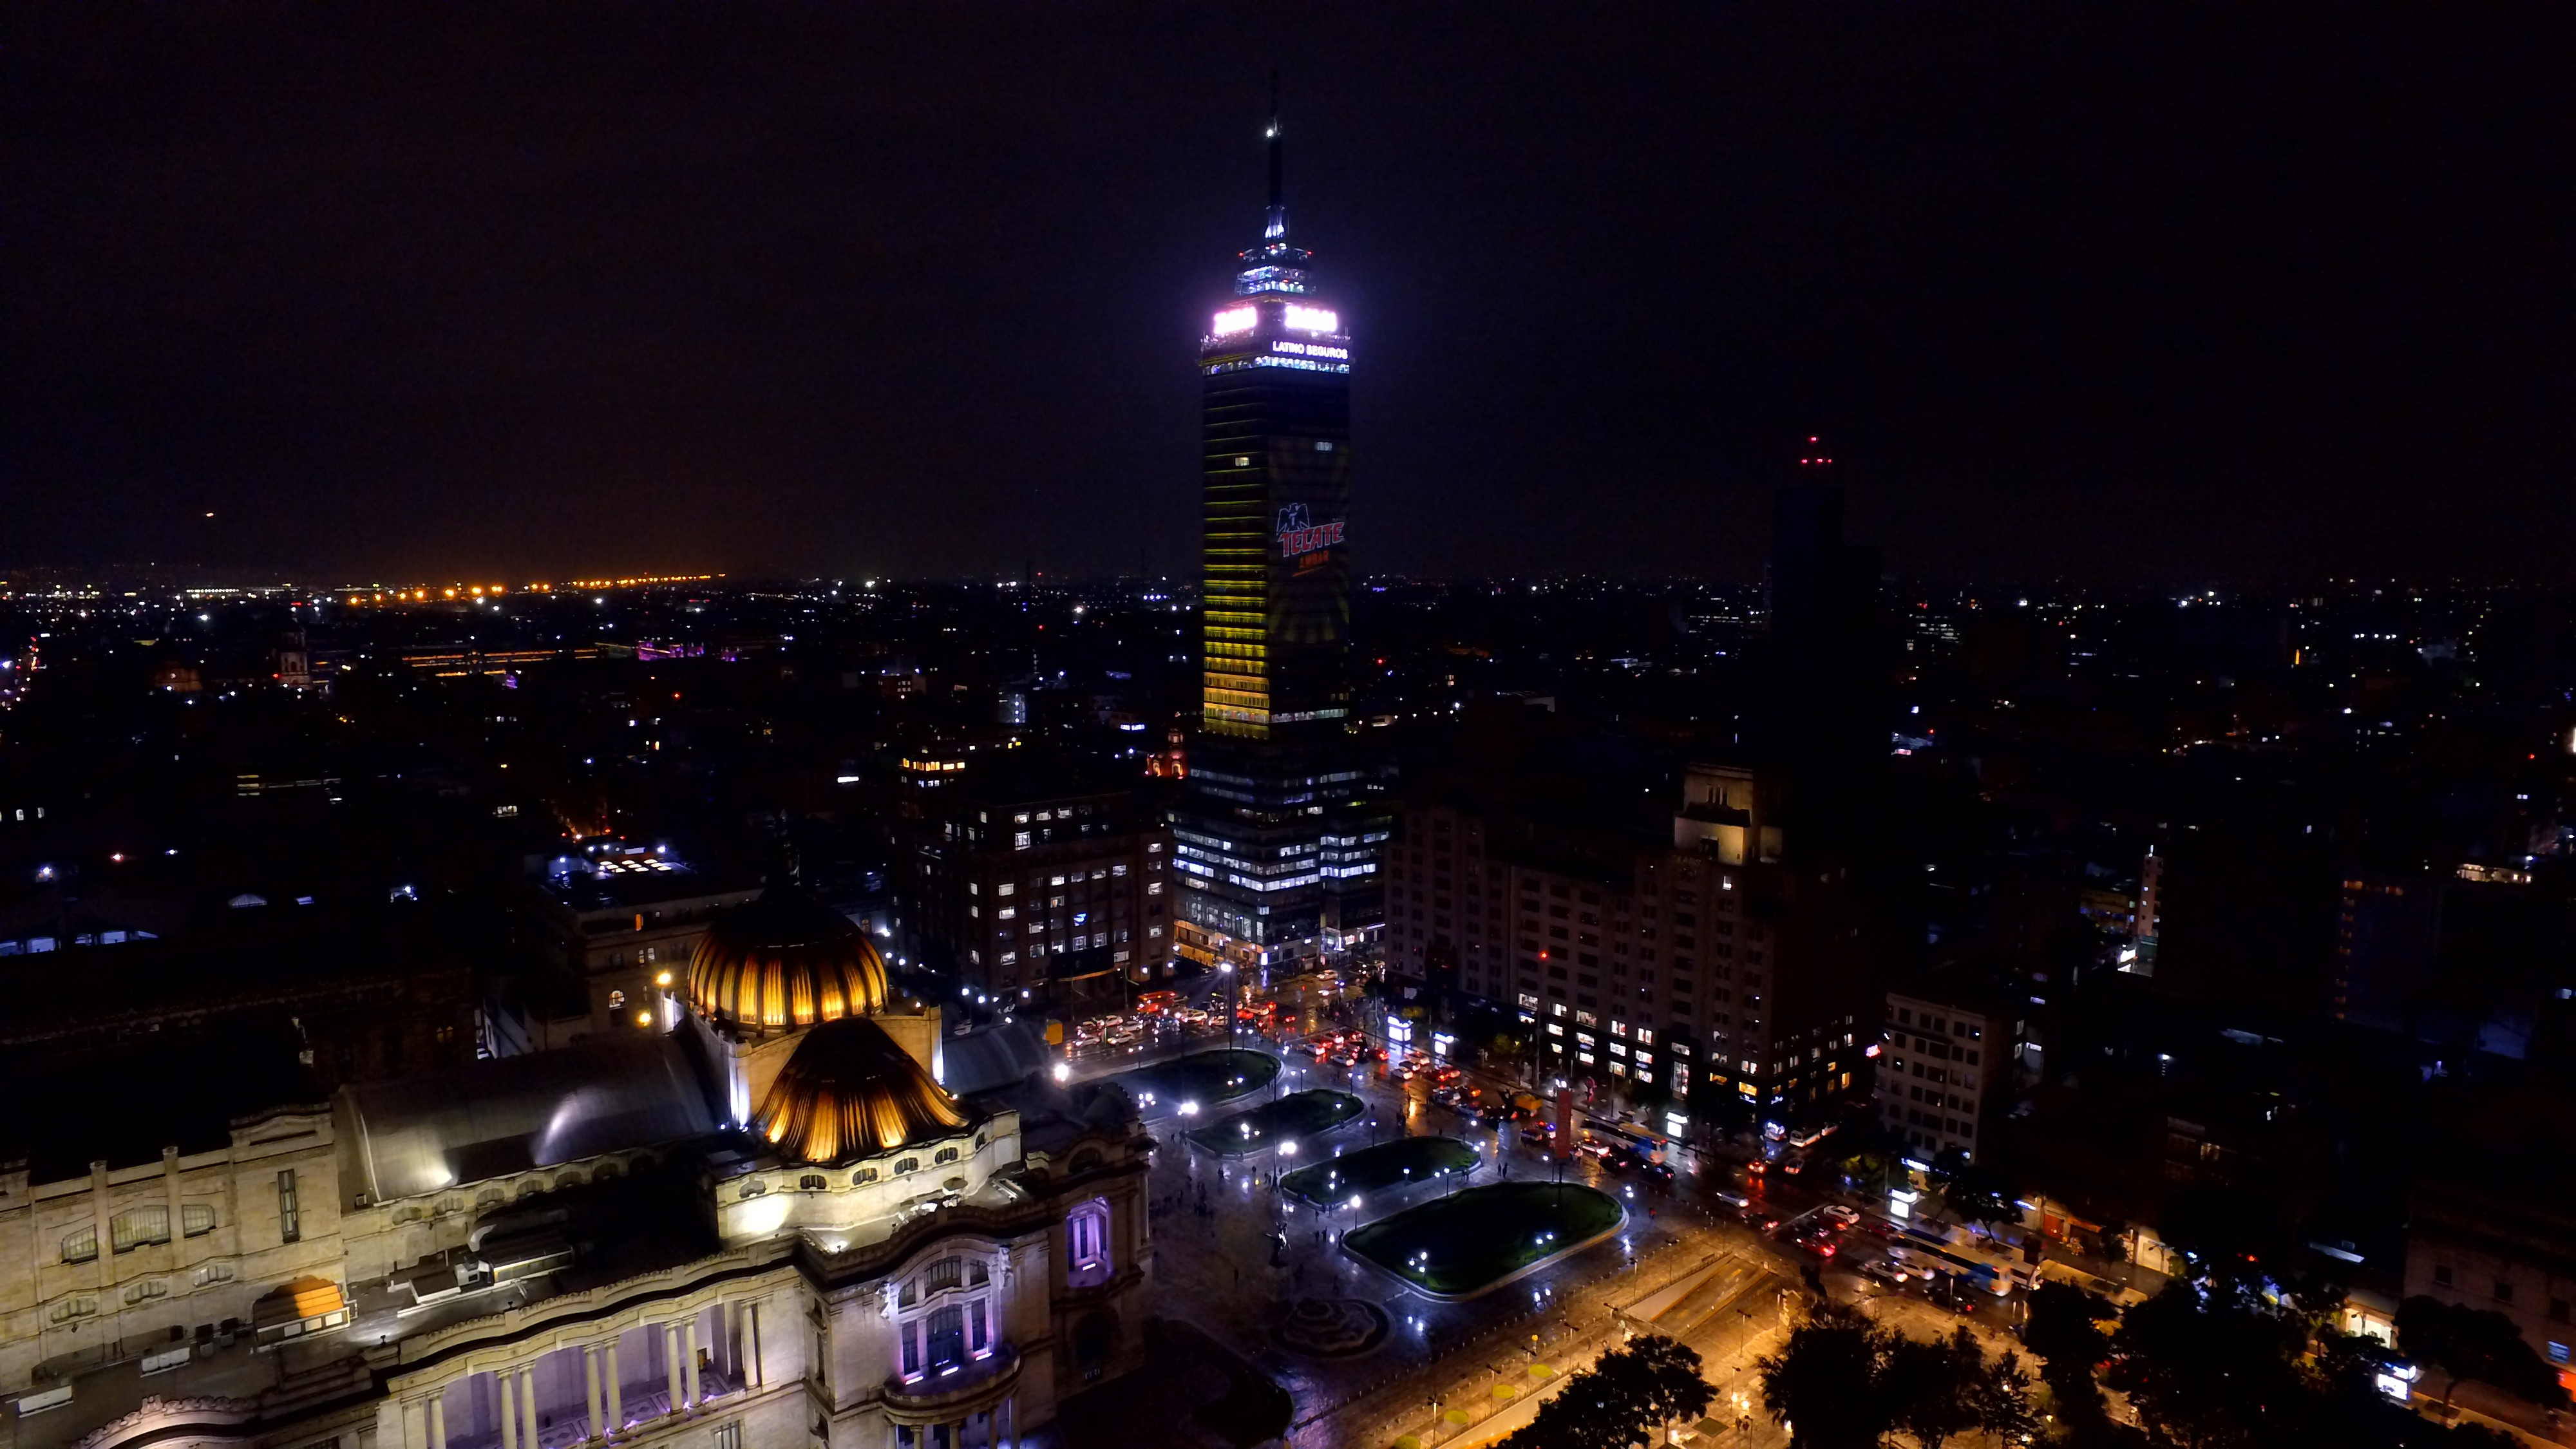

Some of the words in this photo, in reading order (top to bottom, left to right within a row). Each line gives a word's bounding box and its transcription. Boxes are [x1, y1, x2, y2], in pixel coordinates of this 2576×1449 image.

[1273, 341, 1304, 354] LATINO
[1306, 345, 1348, 359] SEGUROS
[1277, 522, 1345, 558] TECATE
